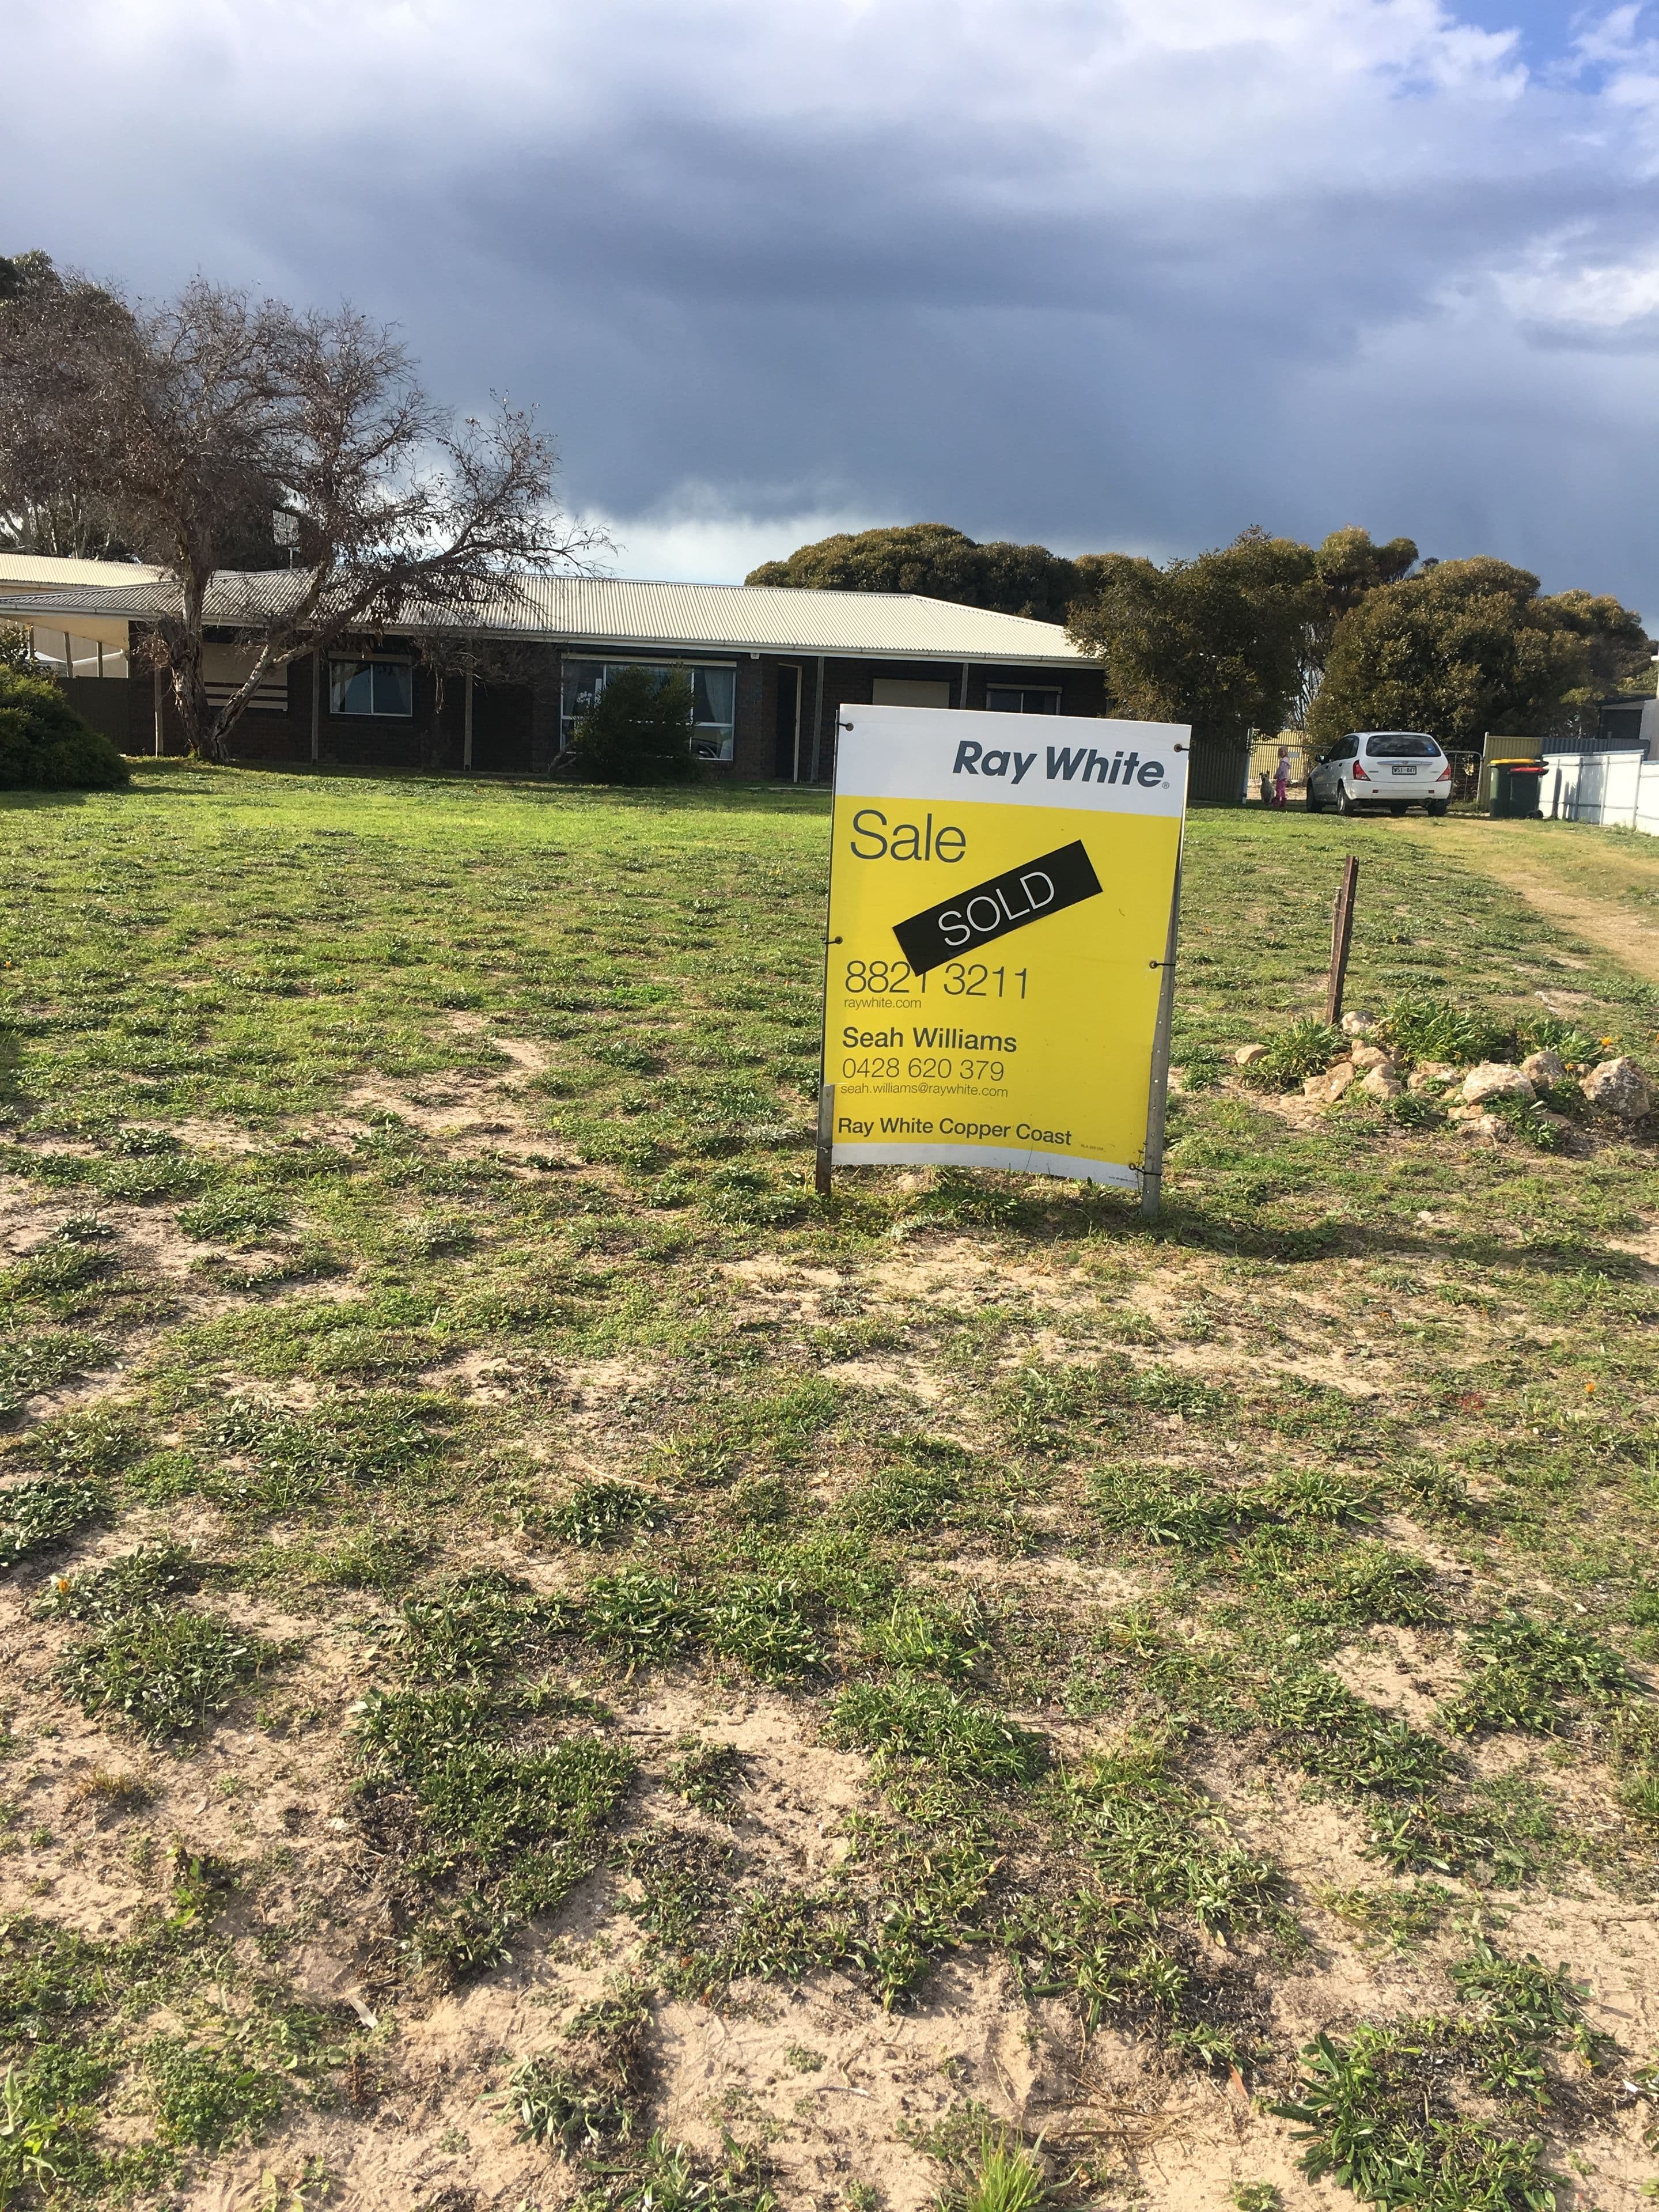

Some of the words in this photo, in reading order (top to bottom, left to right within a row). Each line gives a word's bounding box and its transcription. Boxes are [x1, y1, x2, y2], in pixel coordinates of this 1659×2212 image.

[953, 740, 1037, 784] Ray
[1047, 746, 1164, 787] White
[850, 809, 966, 863] Sale
[938, 871, 1055, 946] SOLD
[944, 963, 1027, 999] 3211
[844, 996, 922, 1010] raywhite.com
[842, 1027, 904, 1048] Seah
[912, 1027, 1017, 1052] Williams
[842, 1058, 900, 1079] 0428
[908, 1058, 952, 1079] 620
[960, 1059, 1004, 1081] 379
[840, 1082, 1009, 1097] seah.williams@raywhite.com
[838, 1118, 874, 1137] Ray
[880, 1117, 934, 1134] White
[939, 1118, 1012, 1139] Copper
[1016, 1123, 1072, 1146] Coast
